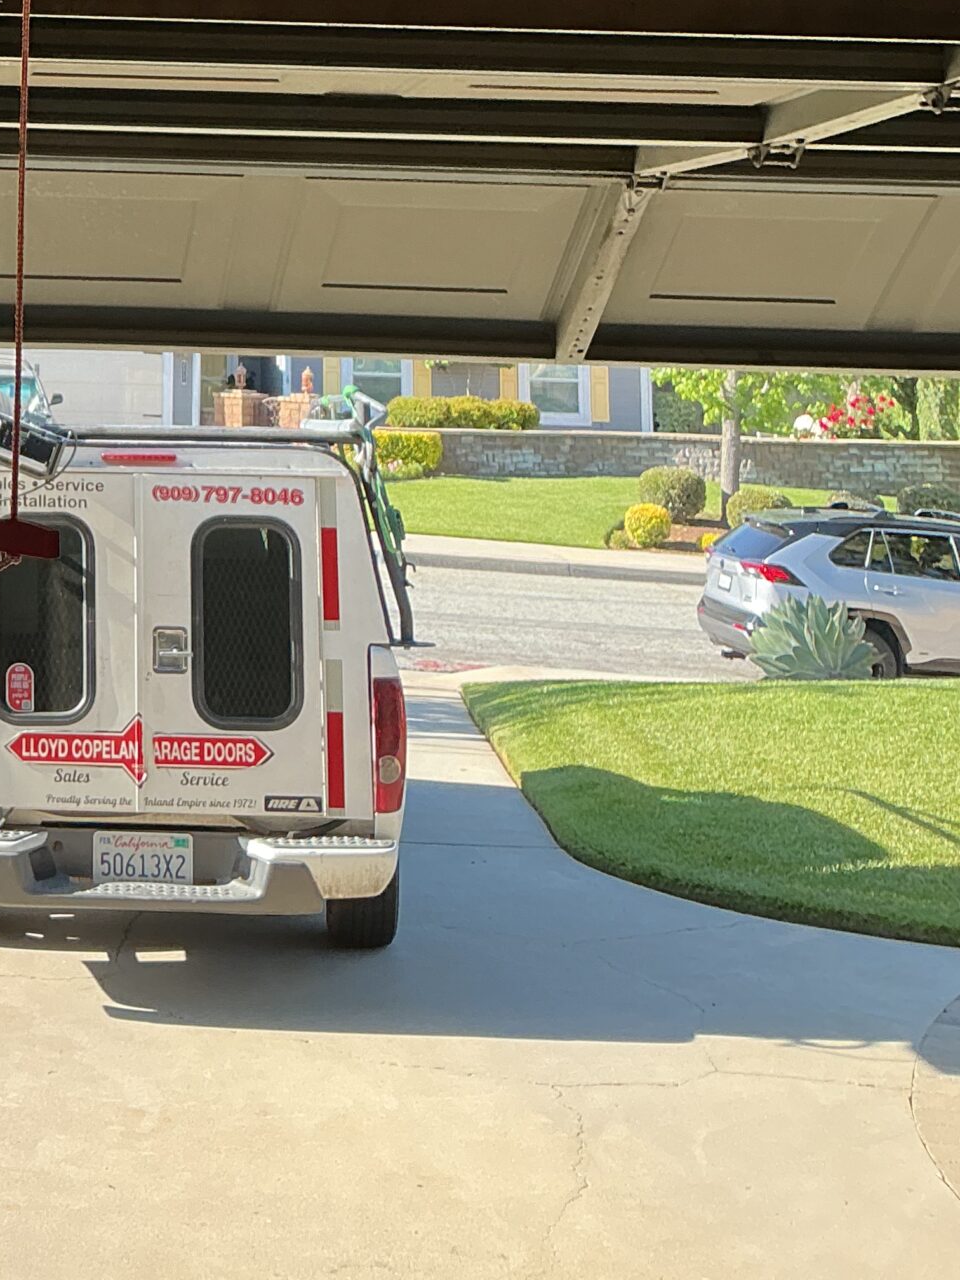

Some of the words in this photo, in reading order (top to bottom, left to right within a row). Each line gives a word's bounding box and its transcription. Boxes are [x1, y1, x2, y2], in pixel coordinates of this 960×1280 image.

[44, 478, 105, 492] Service
[152, 485, 200, 502] (909)
[201, 485, 305, 506] 797-8046
[21, 737, 69, 758] LLOYD
[71, 738, 139, 760] COPELAN
[153, 740, 201, 761] ARAGE
[203, 742, 256, 763] DOORS
[53, 768, 91, 783] Sales
[180, 770, 230, 787] Service
[46, 793, 81, 807] Proudly
[83, 794, 117, 808] Serving
[119, 795, 133, 806] the
[143, 796, 175, 807] Inland
[176, 797, 207, 810] Empire
[208, 798, 231, 809] since
[113, 835, 171, 853] California
[100, 851, 187, 880] 50613X2
